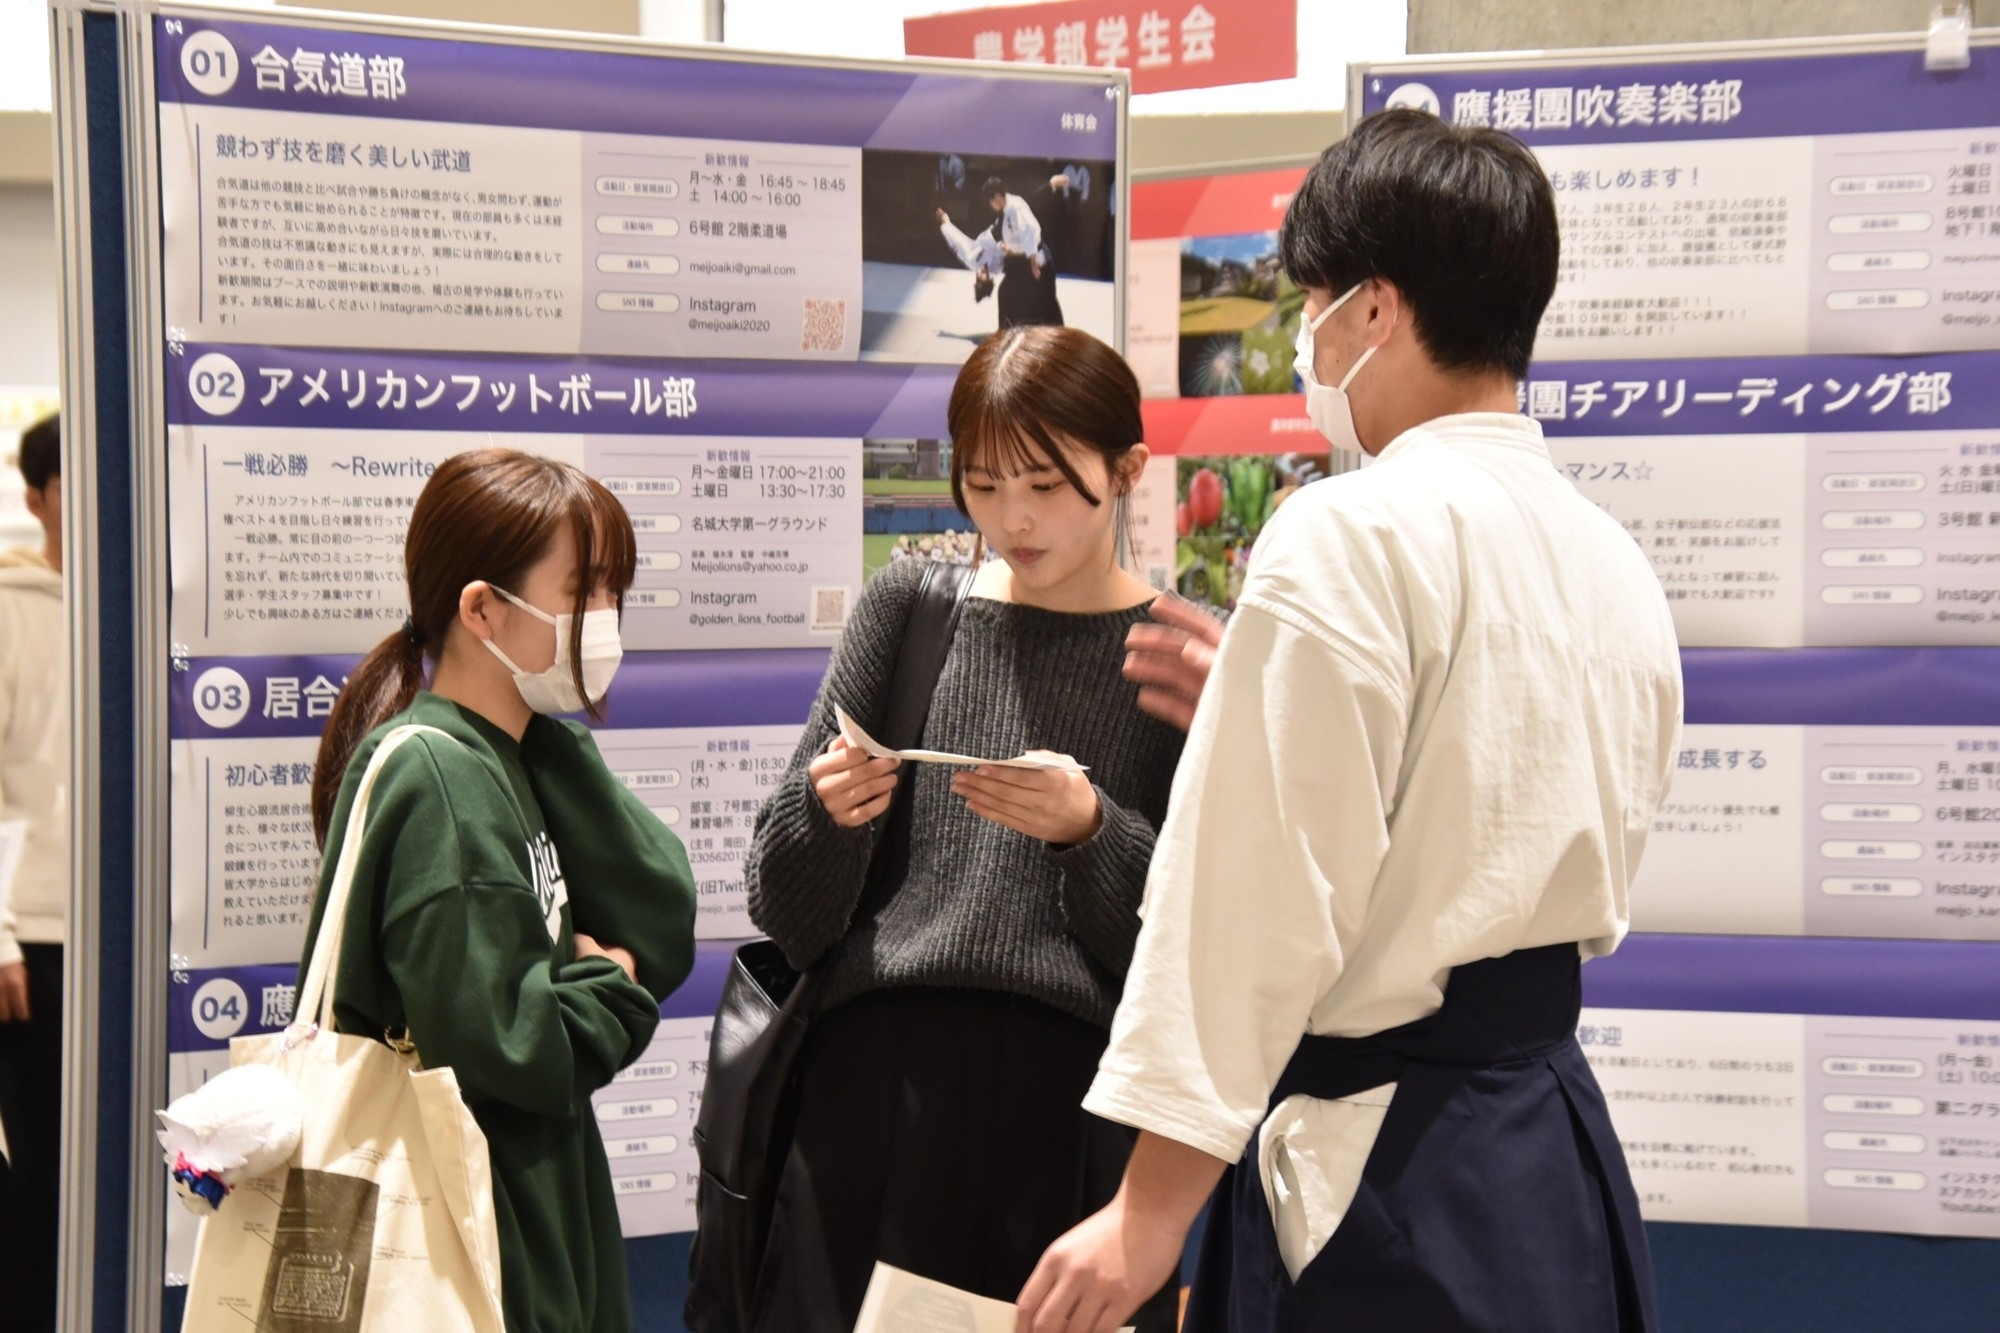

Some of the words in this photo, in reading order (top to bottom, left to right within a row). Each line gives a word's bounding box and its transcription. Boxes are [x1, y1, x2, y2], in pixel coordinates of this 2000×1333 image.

[973, 5, 1216, 67] 農学部学生会
[189, 50, 228, 79] 01
[250, 44, 407, 100] 合気道部
[1453, 79, 1743, 130] 應援團吹奏楽部
[1060, 112, 1098, 131] 体育会
[215, 133, 473, 173] 競わず技を磨く美しい武道
[704, 153, 750, 168] 新歓情報
[759, 174, 793, 189] 16:45
[812, 177, 847, 192] 18:45
[689, 189, 700, 202] 土
[713, 190, 748, 204] 14:00
[768, 193, 801, 206] 16:00
[689, 221, 724, 236] 6号館
[728, 222, 787, 240] 2階柔道場
[689, 261, 796, 276] meijoaiki@gmail.com
[689, 297, 757, 314] Instagram
[688, 318, 770, 332] @meijoaiki2020
[195, 370, 236, 398] 02
[258, 367, 699, 420] アメリカンフットボール部
[222, 452, 309, 477] 一戦必勝
[706, 449, 751, 462] 新歓情報
[691, 484, 728, 498] 土曜日
[234, 494, 417, 508] アメリカンフットボール部では春季東
[691, 517, 828, 532] 名城大学第一グラウンド
[690, 561, 809, 575] Meijolions@yahoo.co.jp
[690, 590, 757, 606] Instagram
[688, 612, 806, 626] @golden_lions_football
[200, 684, 242, 711] 03
[262, 674, 349, 720] 居合
[706, 739, 751, 752] 新歓情報
[1677, 748, 1767, 770] 成長する
[224, 762, 318, 788] 初心者歓
[690, 775, 709, 790] (木)
[199, 995, 240, 1023] 04
